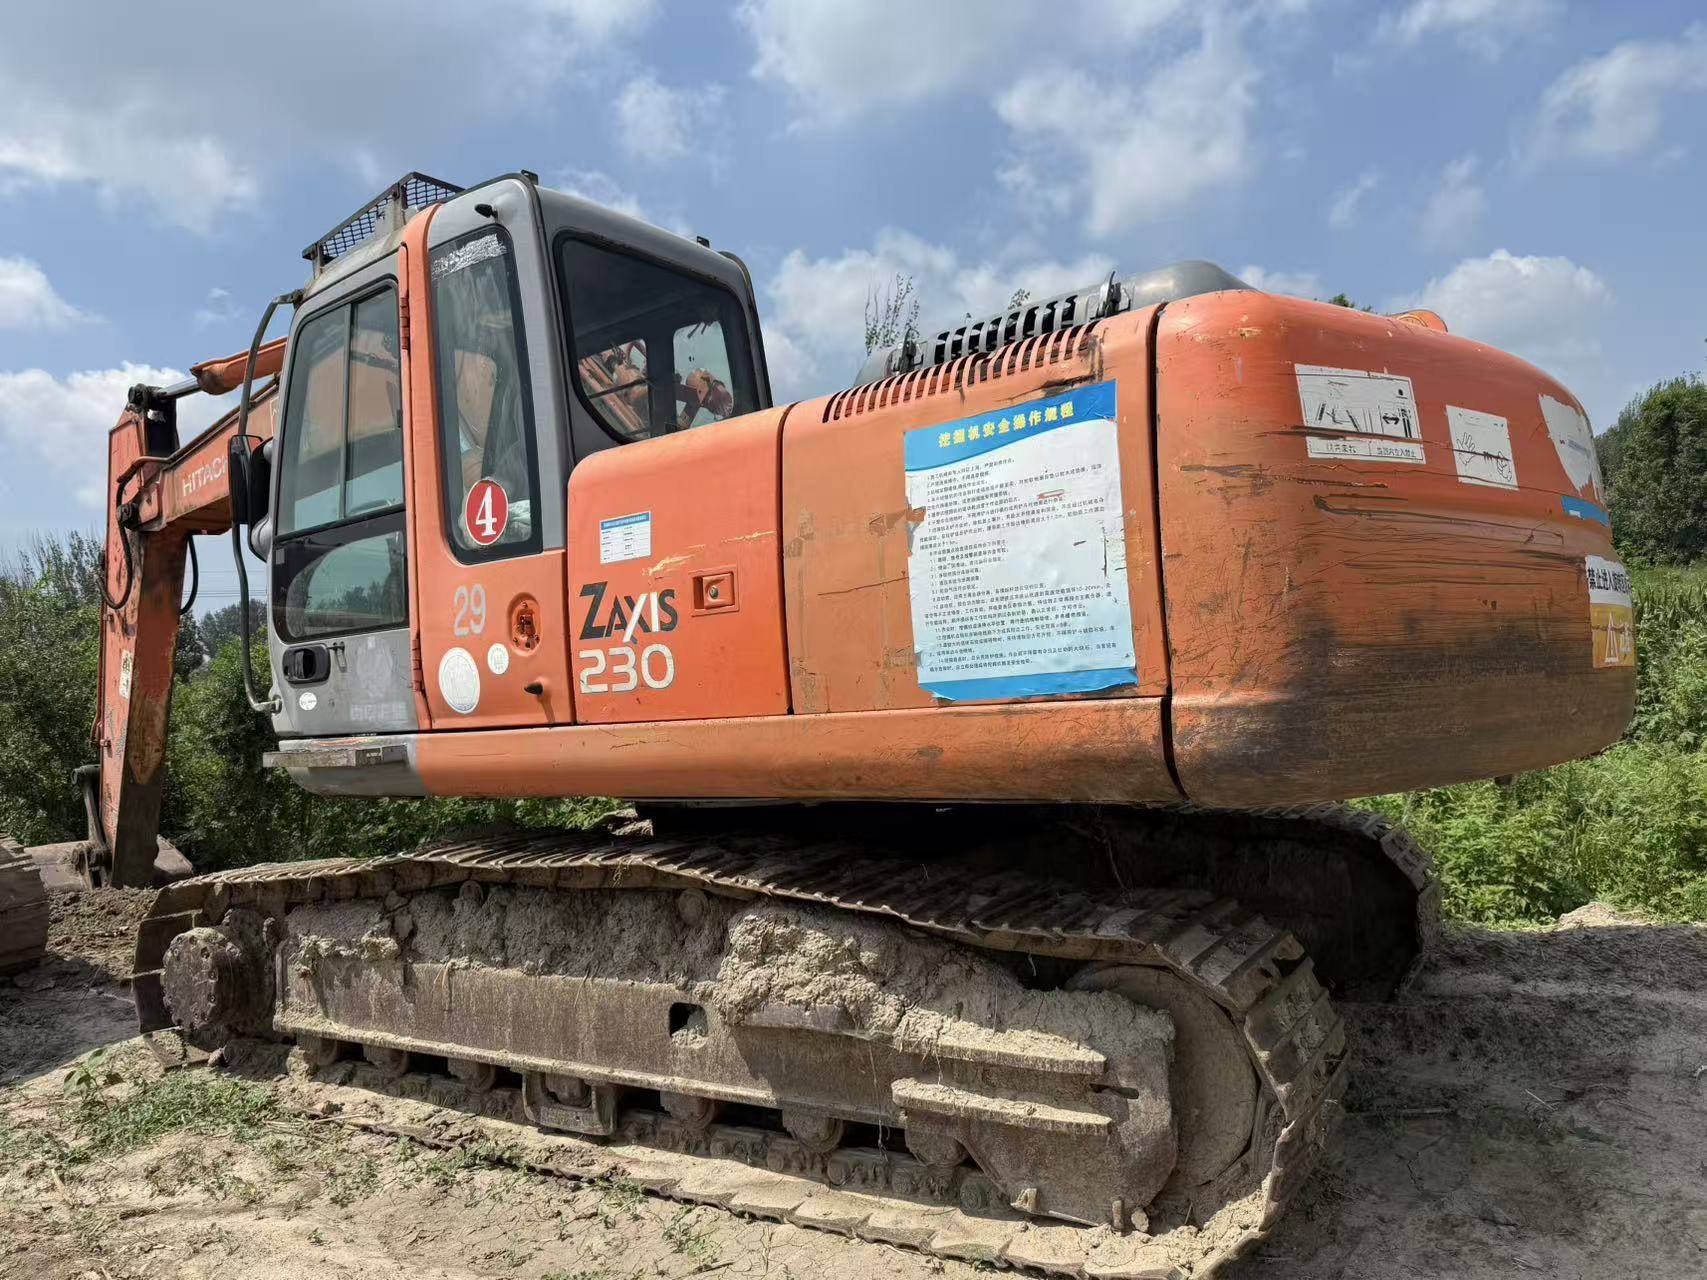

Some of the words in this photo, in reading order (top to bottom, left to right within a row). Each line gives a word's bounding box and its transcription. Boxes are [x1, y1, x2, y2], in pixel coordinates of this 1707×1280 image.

[475, 486, 499, 537] 4
[454, 584, 486, 636] 29
[579, 643, 675, 694] 230
